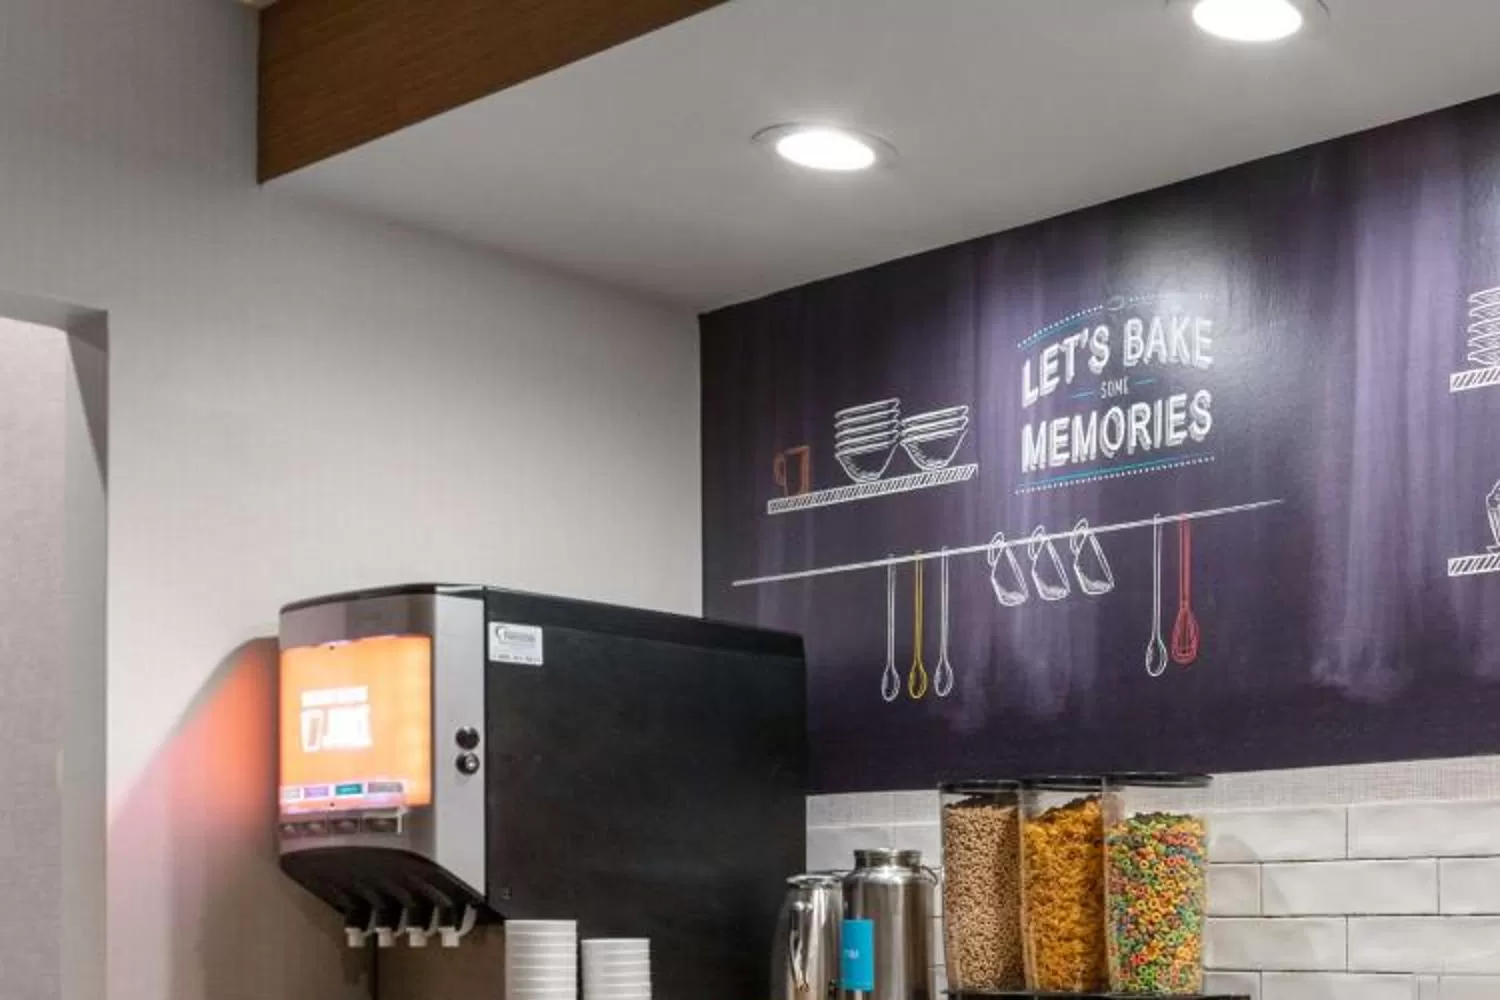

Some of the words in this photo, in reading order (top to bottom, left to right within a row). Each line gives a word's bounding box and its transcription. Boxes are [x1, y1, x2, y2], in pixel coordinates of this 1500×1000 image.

[1021, 325, 1110, 408] LET'S
[1123, 315, 1214, 370] BAKE
[1101, 376, 1129, 398] SOME
[1021, 389, 1213, 473] MEMORIES
